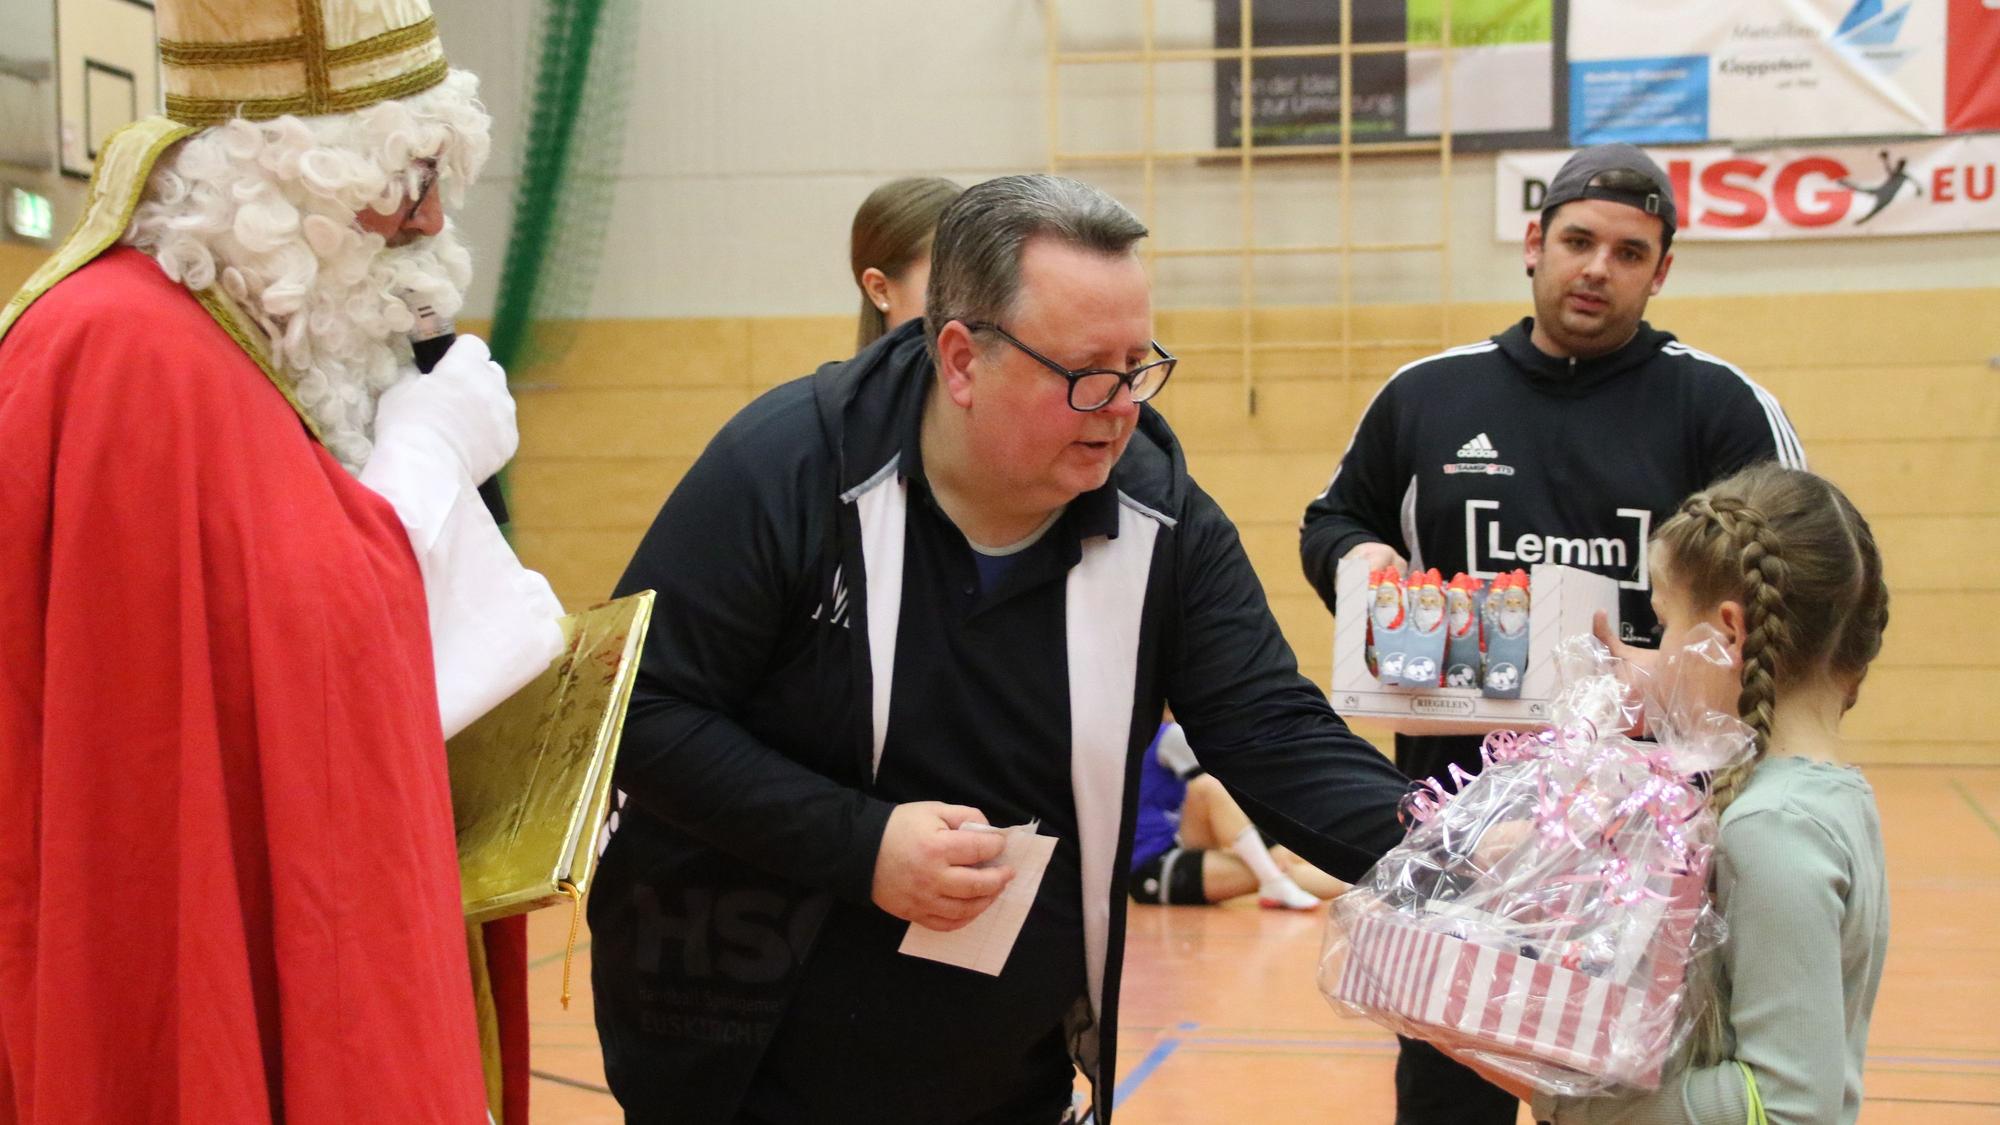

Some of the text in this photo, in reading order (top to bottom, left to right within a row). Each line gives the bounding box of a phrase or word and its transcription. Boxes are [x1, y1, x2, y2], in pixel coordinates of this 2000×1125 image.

[1719, 57, 1811, 76] Kloppstein
[1457, 449, 1498, 459] adidas
[1488, 520, 1627, 567] Lemm
[1417, 698, 1469, 708] RIEGELEIN
